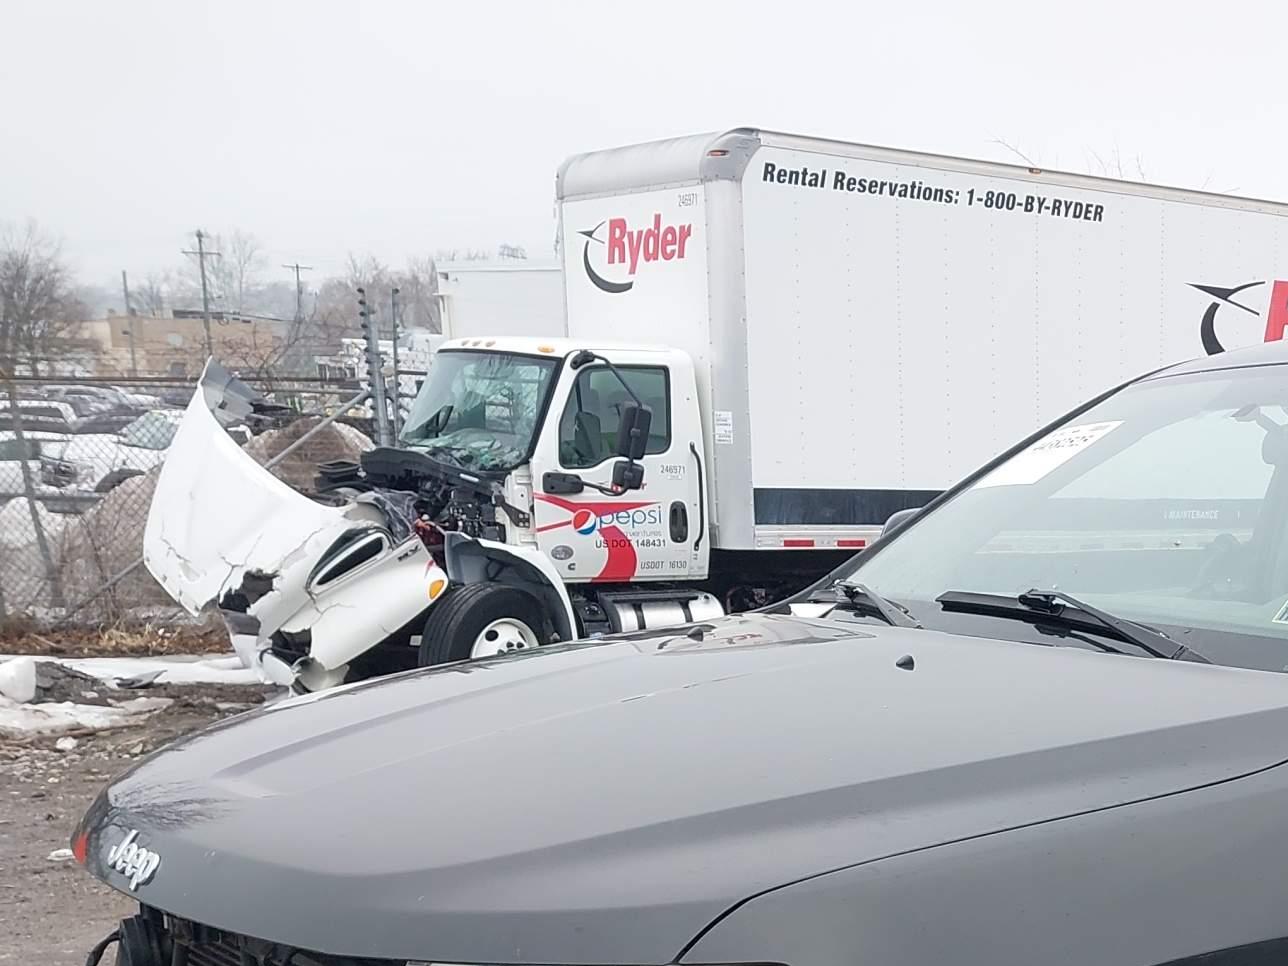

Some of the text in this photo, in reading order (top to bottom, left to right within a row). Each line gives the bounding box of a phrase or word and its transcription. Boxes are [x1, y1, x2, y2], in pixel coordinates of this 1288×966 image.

[762, 162, 1104, 222] Rental Reservations: 1-800-BY-RYDER
[607, 213, 692, 275] Ryder
[660, 464, 686, 474] 246971
[599, 505, 662, 529] pepsi
[595, 538, 666, 549] US DOT 148431
[640, 560, 665, 570] USDOT
[668, 560, 687, 569] 16130
[107, 829, 161, 892] Jeep
